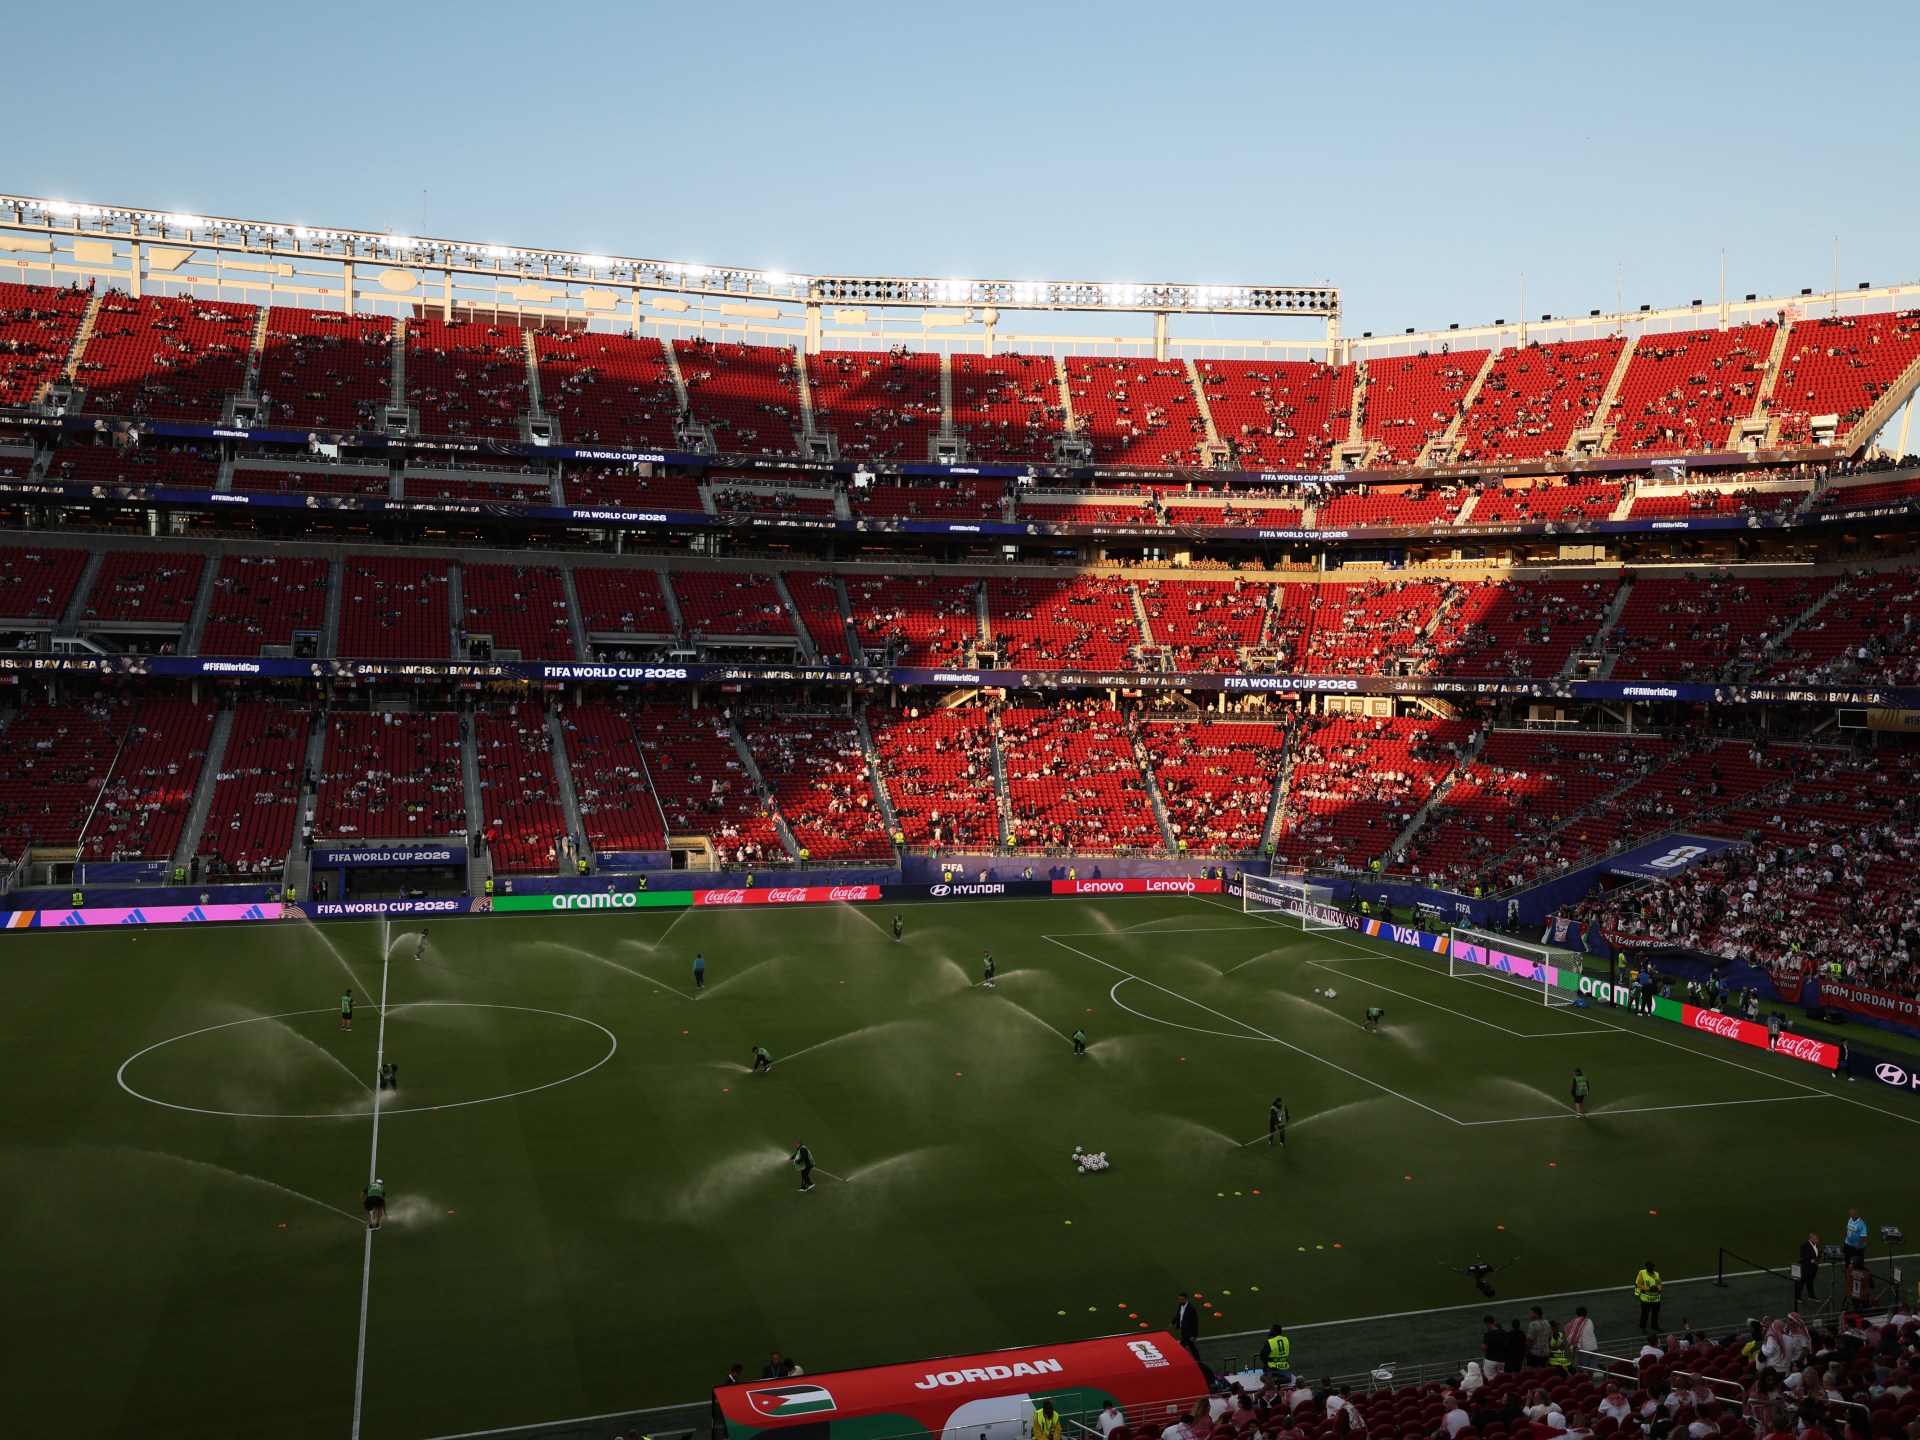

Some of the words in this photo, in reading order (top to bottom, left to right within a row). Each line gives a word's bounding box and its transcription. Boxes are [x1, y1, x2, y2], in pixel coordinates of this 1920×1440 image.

[576, 450, 592, 458] FIFA
[594, 451, 620, 460] WORLD
[638, 453, 664, 462] 2026
[573, 511, 590, 519] FIFA
[592, 512, 620, 520] WORLD
[639, 513, 667, 522] 2026
[34, 660, 60, 669] BAY
[63, 660, 97, 669] AREA
[203, 662, 259, 672] #FIFAWorldCup
[450, 666, 470, 675] BAY
[473, 667, 502, 675] AREA
[544, 667, 571, 677] FIFA
[573, 667, 615, 678] WORLD
[618, 668, 643, 678] CUP
[644, 668, 686, 679] 2026
[806, 671, 824, 679] BAY
[826, 671, 851, 679] AREA
[934, 674, 979, 682] #FIFAWorldCup
[1061, 676, 1082, 684] SAN
[1140, 677, 1160, 685] BAY
[1161, 677, 1187, 685] AREA
[1224, 678, 1248, 687] FIFA
[1250, 679, 1290, 688] WORLD
[1292, 679, 1316, 688] CUP
[1318, 680, 1358, 689] 2026
[1396, 682, 1416, 690] SAN
[1478, 684, 1498, 692] BAY
[1500, 684, 1528, 692] AREA
[1623, 688, 1676, 696] #FIFAWorldCup
[1750, 691, 1769, 700] SAN
[1829, 693, 1848, 702] BAY
[1852, 693, 1880, 703] AREA
[328, 854, 351, 862] FIFA
[353, 853, 390, 861] WORLD
[392, 852, 412, 860] CUP
[414, 851, 450, 860] 2026
[942, 863, 963, 872] FIFA
[953, 884, 1004, 894] HYUNDAI
[1076, 881, 1124, 892] Lenovo
[1146, 880, 1195, 891] Lenovo
[1228, 885, 1242, 896] ADI
[704, 889, 746, 904] Coca-Cola
[768, 888, 807, 902] Coca-Cola
[830, 885, 868, 900] Coca-Cola
[552, 892, 636, 909] aramco
[317, 904, 342, 914] FIFA
[345, 903, 388, 913] WORLD
[390, 902, 412, 912] CUP
[1456, 903, 1471, 914] FIFA
[1392, 925, 1420, 948] VISA
[1615, 935, 1635, 946] TEAM
[1851, 991, 1895, 1009] JORDAN
[1898, 1001, 1912, 1013] TO
[1695, 1010, 1740, 1039] Coca-Cola
[915, 1358, 1064, 1390] JORDAN
